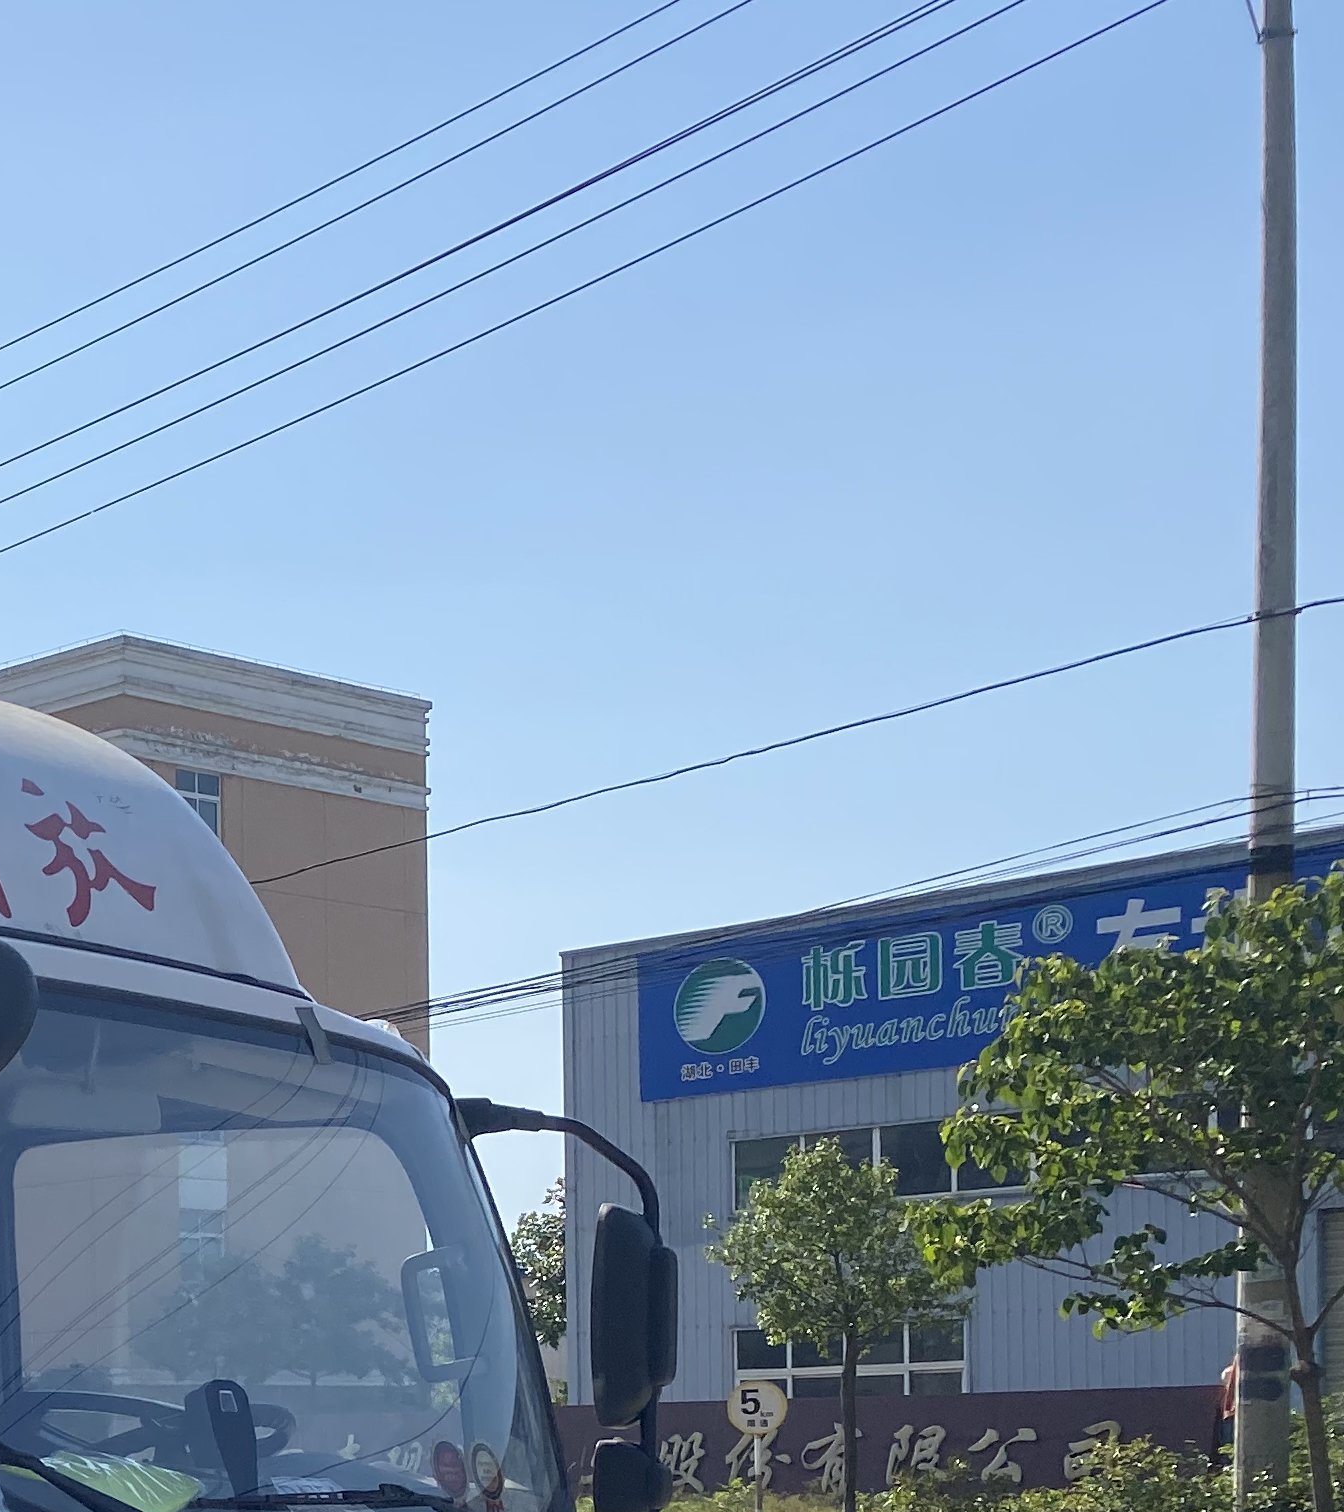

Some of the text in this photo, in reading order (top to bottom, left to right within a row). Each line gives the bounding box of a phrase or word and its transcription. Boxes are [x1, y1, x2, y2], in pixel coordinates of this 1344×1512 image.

[740, 1388, 761, 1416] 5
[577, 1419, 1124, 1496] 股份有限公司
